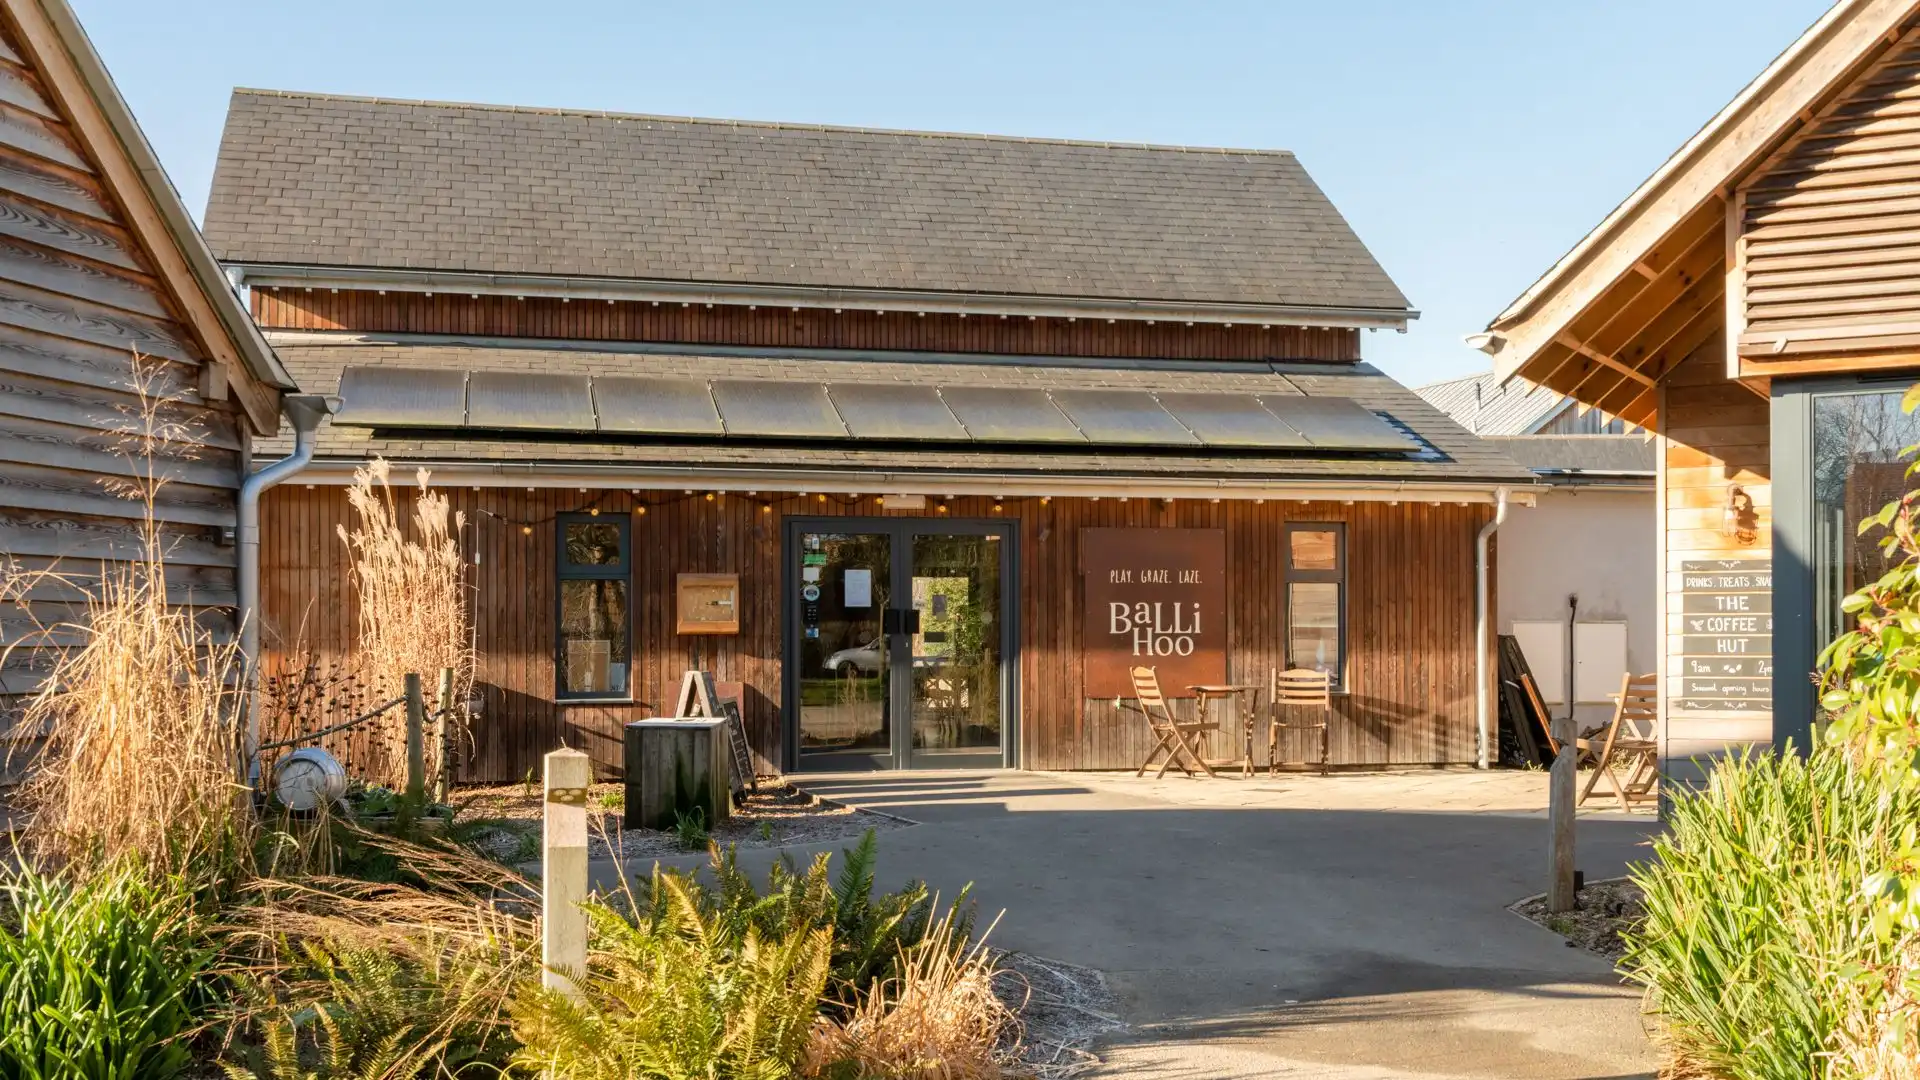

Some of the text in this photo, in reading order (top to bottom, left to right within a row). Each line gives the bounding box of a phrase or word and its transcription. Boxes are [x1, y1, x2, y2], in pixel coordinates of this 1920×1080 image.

[1110, 569, 1203, 584] PLAY. GRAZE. LAZE.
[1715, 595, 1750, 611] THE
[1707, 617, 1757, 632] COFFEE
[1716, 638, 1749, 653] HUT
[1691, 660, 1711, 673] 9am
[1722, 685, 1747, 696] opening
[1752, 681, 1770, 692] hours
